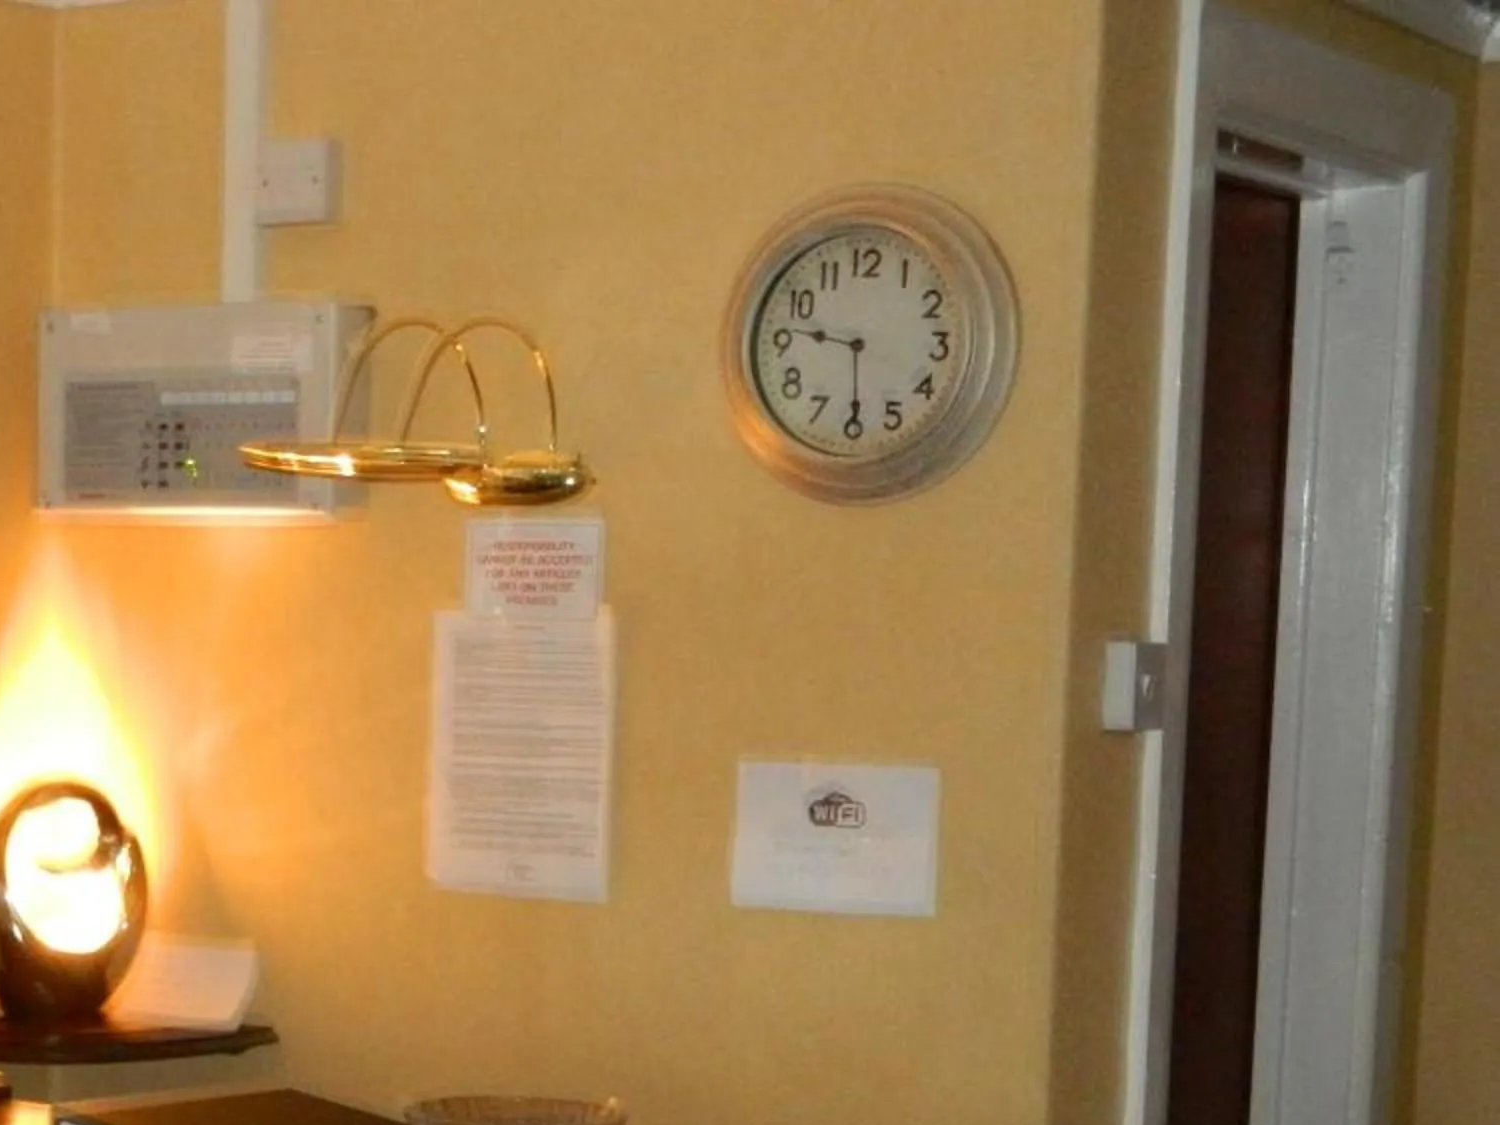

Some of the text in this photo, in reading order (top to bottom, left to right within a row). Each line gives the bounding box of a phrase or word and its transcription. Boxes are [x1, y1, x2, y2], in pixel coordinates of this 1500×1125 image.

[820, 261, 840, 291] 11
[852, 248, 882, 278] 12
[900, 258, 909, 289] 1
[790, 289, 815, 320] 10
[921, 289, 943, 319] 2
[773, 328, 793, 359] 9
[930, 331, 949, 362] 3
[781, 367, 802, 400] 8
[912, 373, 934, 400] 4
[810, 395, 830, 425] 7
[844, 403, 863, 440] 6
[883, 401, 903, 431] 5
